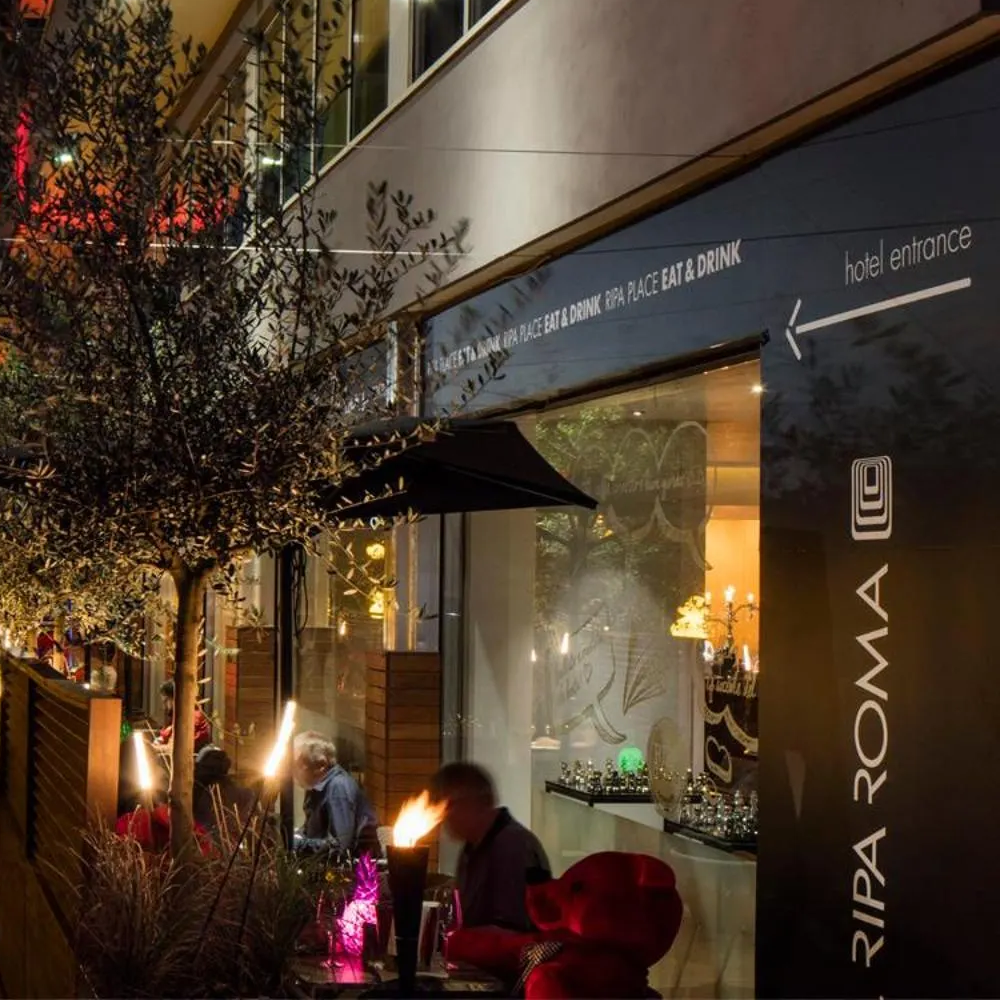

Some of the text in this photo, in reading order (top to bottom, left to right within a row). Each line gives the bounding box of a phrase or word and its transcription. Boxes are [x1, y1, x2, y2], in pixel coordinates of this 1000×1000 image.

[544, 309, 561, 334] EAT
[561, 306, 569, 329] &
[569, 293, 601, 325] DRINK
[604, 285, 626, 311] RIPA
[627, 270, 659, 305] PLACE
[660, 260, 684, 292] EAT
[684, 257, 696, 283] &
[696, 238, 742, 279] DRINK
[844, 225, 972, 286] hotel entrance
[852, 563, 889, 967] RIPA ROMA
